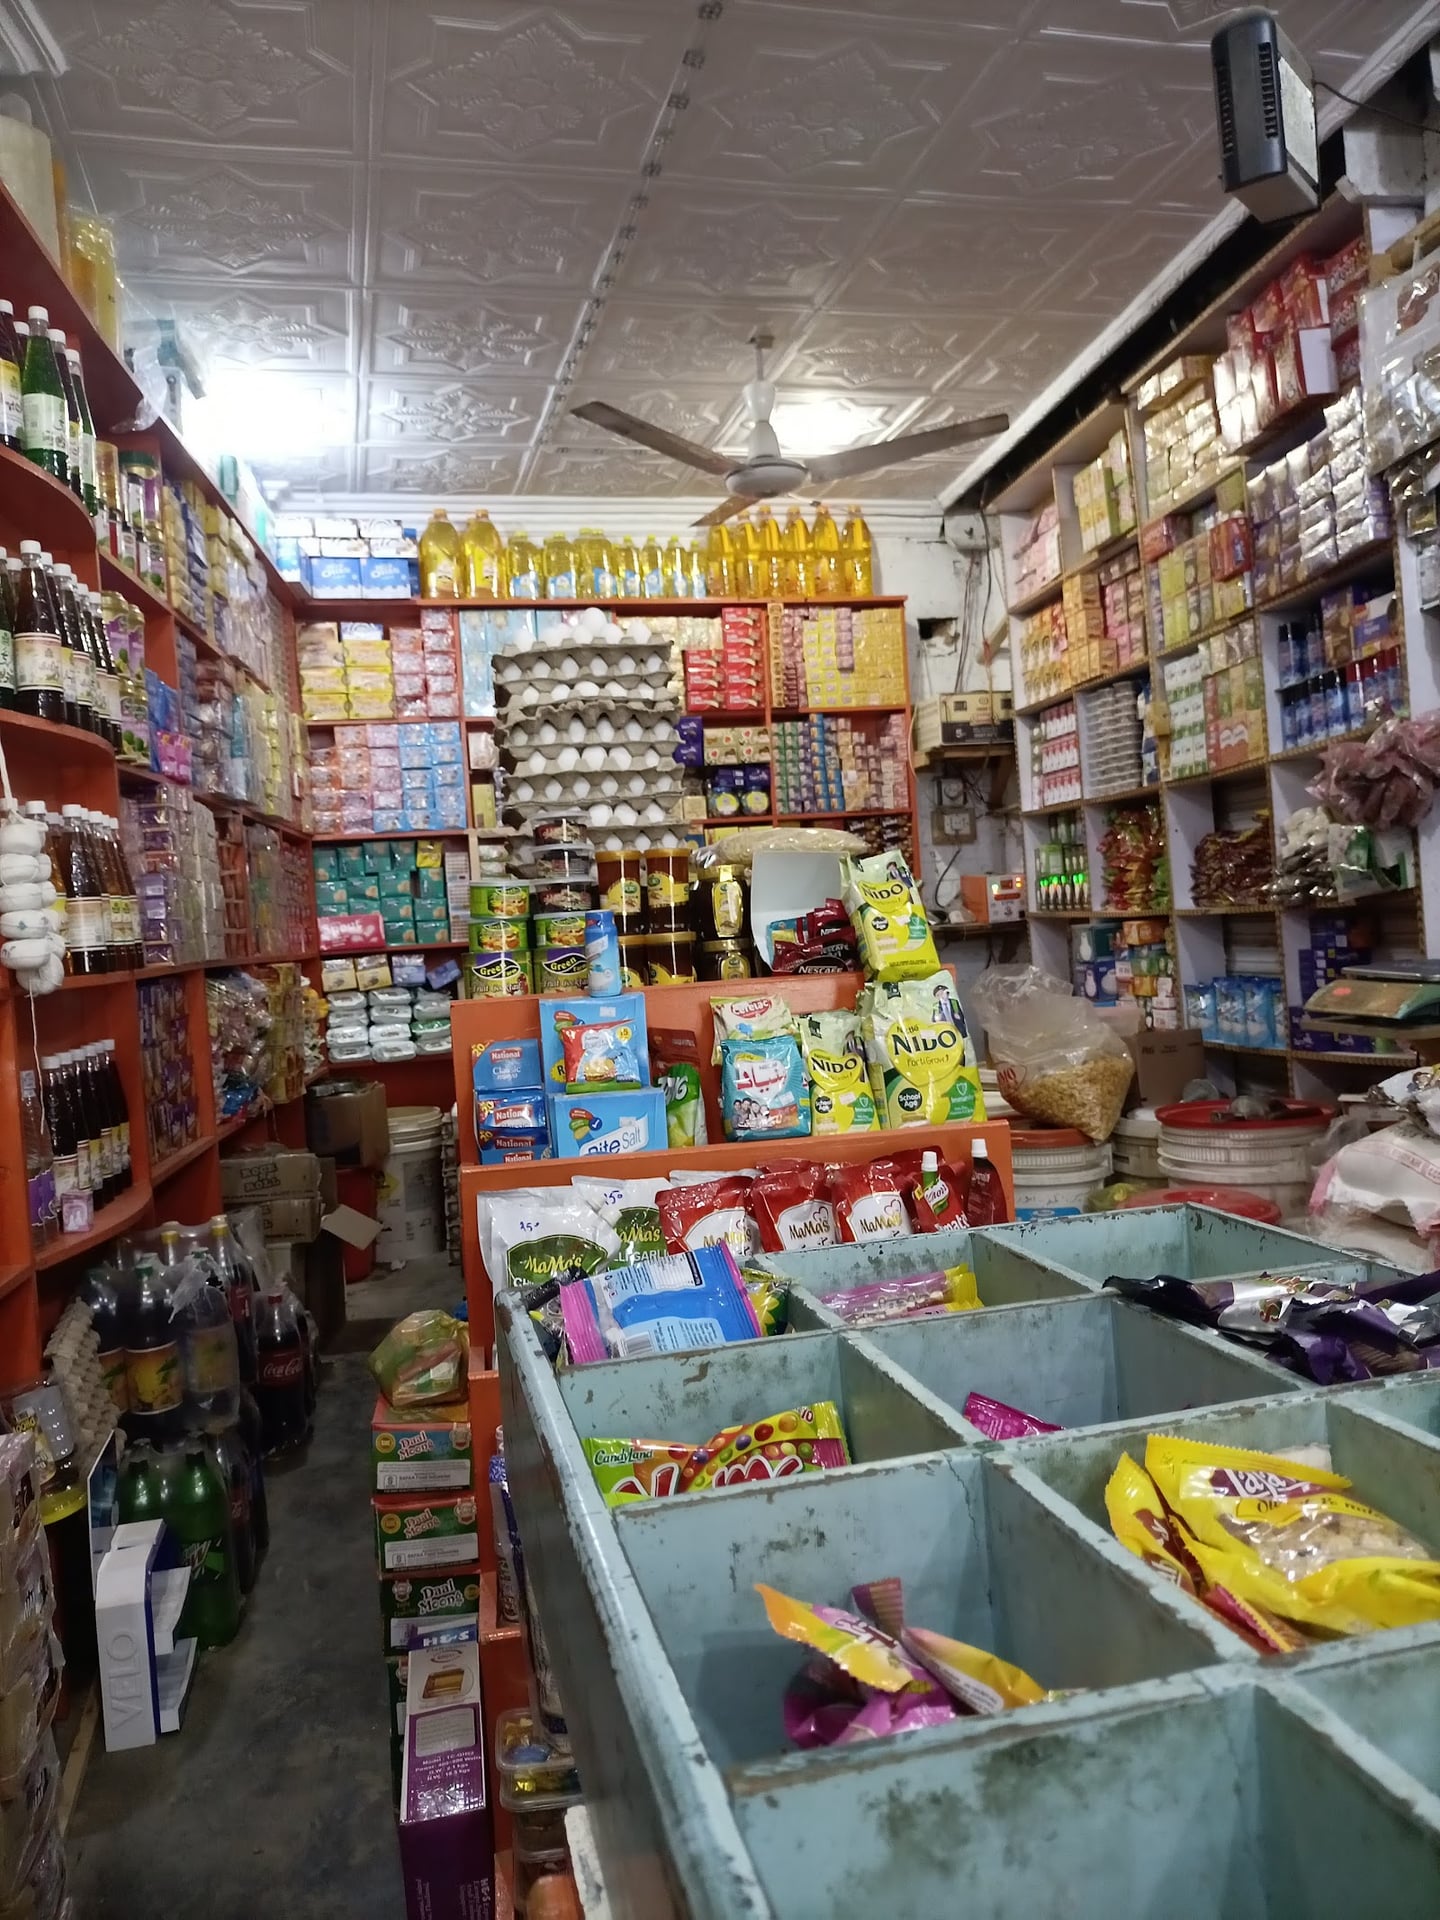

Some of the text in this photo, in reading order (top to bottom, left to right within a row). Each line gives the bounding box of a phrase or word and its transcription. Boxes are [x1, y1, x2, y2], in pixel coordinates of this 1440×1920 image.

[862, 883, 903, 900] NIDO
[550, 956, 577, 971] Green
[891, 1030, 957, 1056] NIDO
[491, 1050, 521, 1060] National
[811, 1056, 857, 1074] NIDO
[622, 1128, 642, 1150] Salt
[504, 1152, 532, 1163] National
